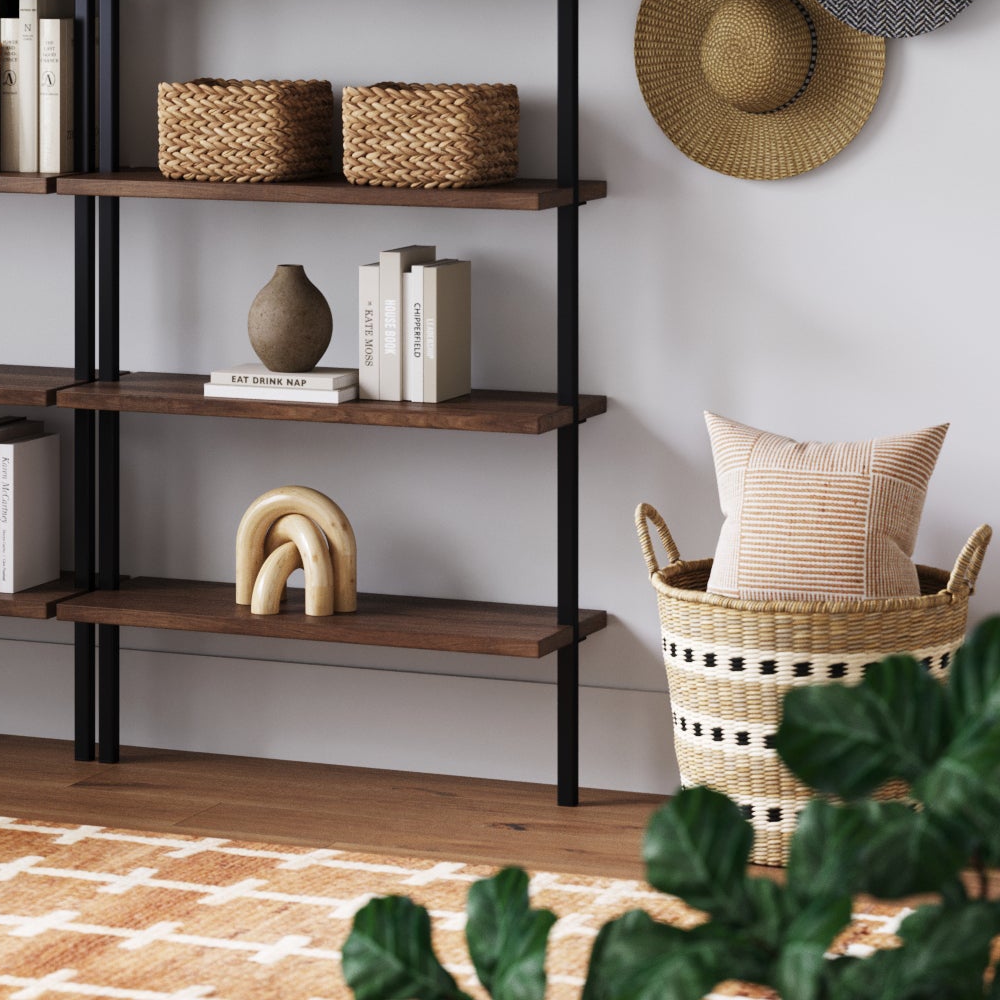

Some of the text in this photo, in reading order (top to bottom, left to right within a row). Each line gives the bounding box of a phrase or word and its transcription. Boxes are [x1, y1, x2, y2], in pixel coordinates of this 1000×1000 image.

[365, 309, 373, 336] KATE
[384, 299, 396, 355] HOUSE BOOK
[413, 303, 421, 358] CHIPPERFIELD
[365, 339, 373, 367] MOSS
[231, 375, 307, 387] EAT DRINK NAP
[1, 456, 10, 480] Karen
